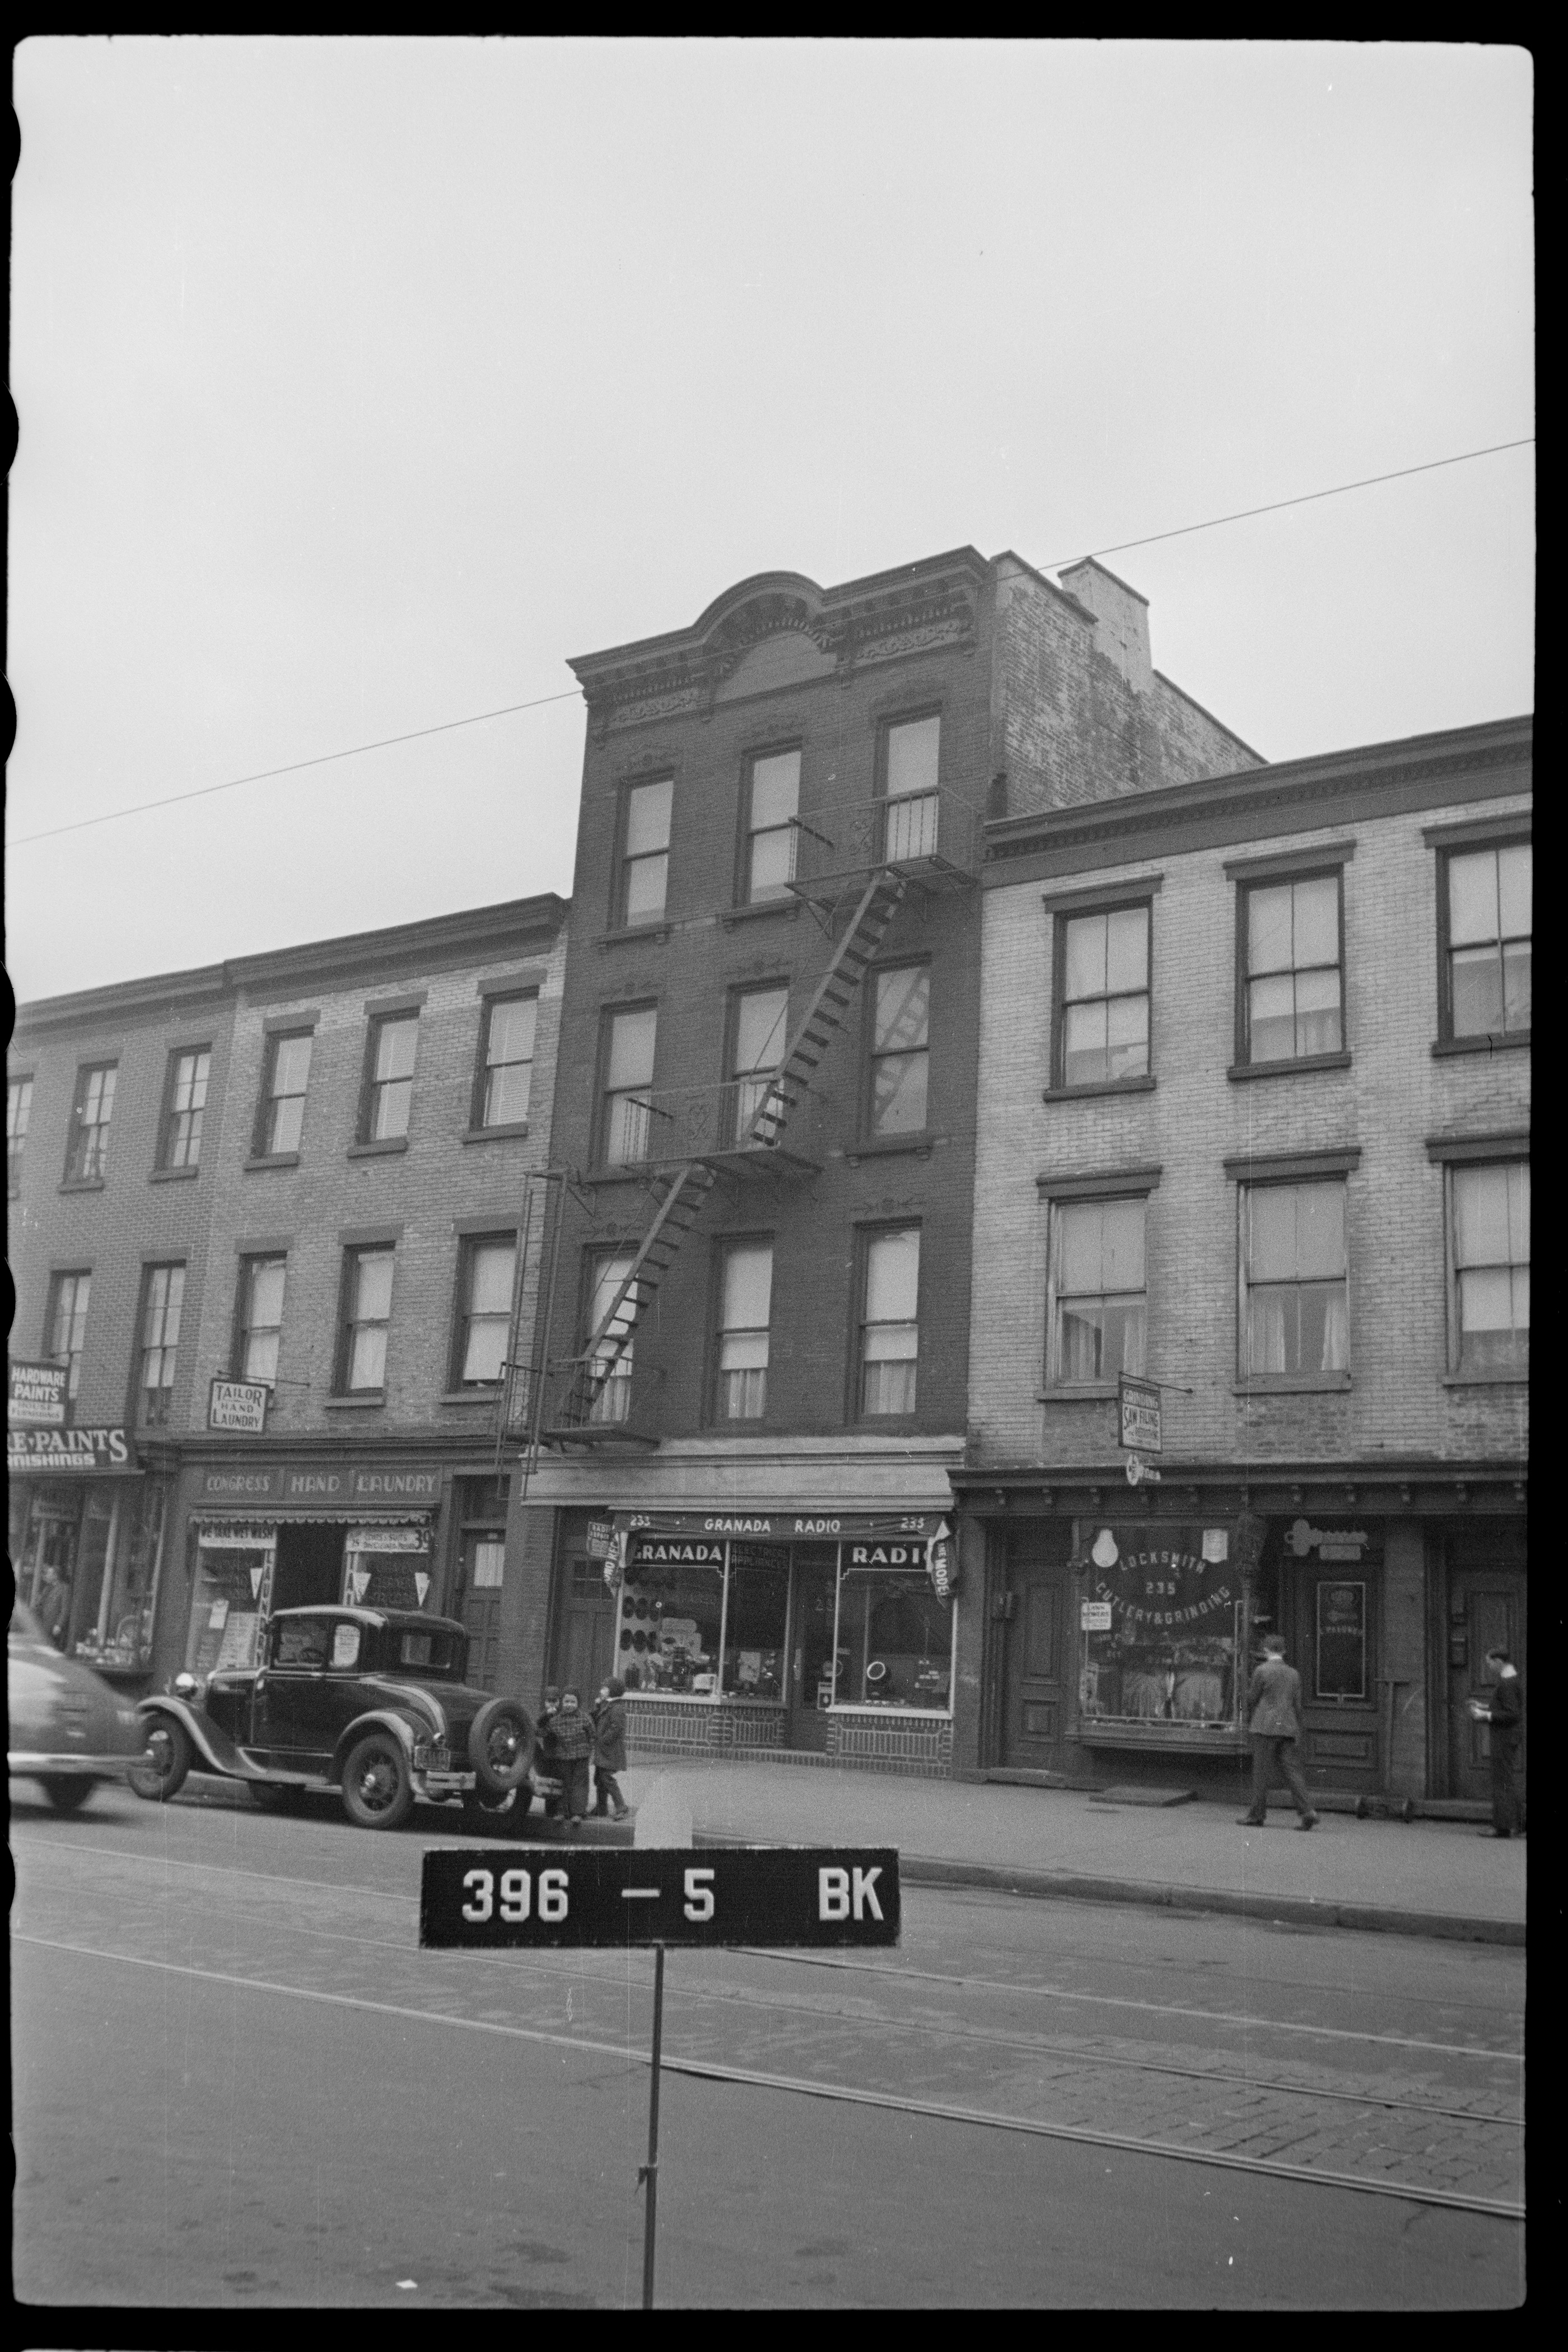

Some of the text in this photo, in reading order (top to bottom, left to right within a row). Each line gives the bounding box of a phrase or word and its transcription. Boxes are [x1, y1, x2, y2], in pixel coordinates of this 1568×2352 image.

[12, 1366, 66, 1388] HARDWARE
[15, 1383, 59, 1402] PAINTS
[216, 1384, 262, 1407] TAILOR
[221, 1402, 254, 1413] HAND
[212, 1408, 260, 1428] LAUNDRY
[34, 1429, 128, 1462] PAINTS
[206, 1474, 436, 1493] CONGRESS HAND LAUNDRY
[629, 1514, 651, 1527] 233
[704, 1518, 771, 1534] GRANADA
[794, 1519, 841, 1533] RADIO
[852, 1547, 927, 1564] RADI
[1120, 1551, 1206, 1575] LOCKSMITH
[1146, 1581, 1175, 1595] 235
[463, 1869, 569, 1920] 396
[684, 1868, 715, 1920] 5
[819, 1868, 884, 1920] BK
